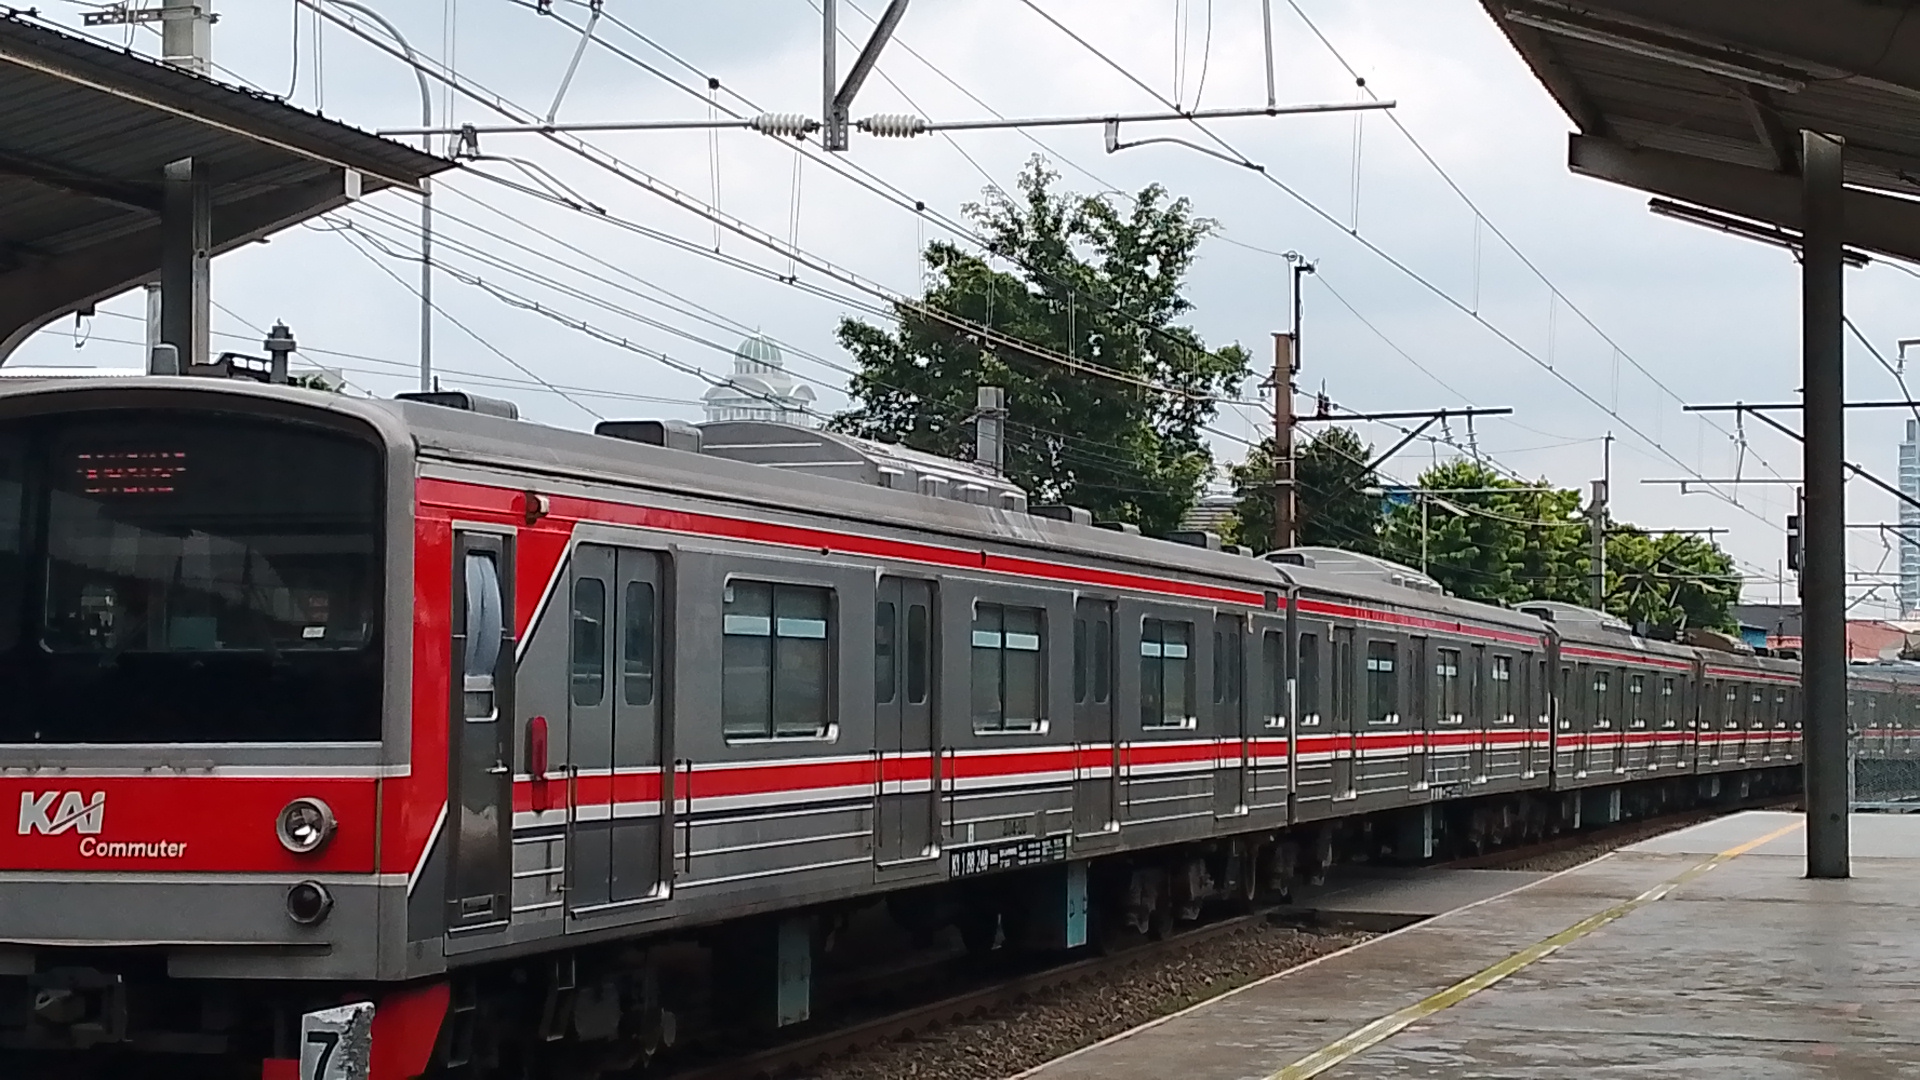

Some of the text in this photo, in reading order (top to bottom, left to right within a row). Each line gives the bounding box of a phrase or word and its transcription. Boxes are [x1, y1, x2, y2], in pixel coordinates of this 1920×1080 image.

[18, 791, 105, 834] KAI
[80, 837, 187, 857] Commuter
[307, 1031, 339, 1080] 7
